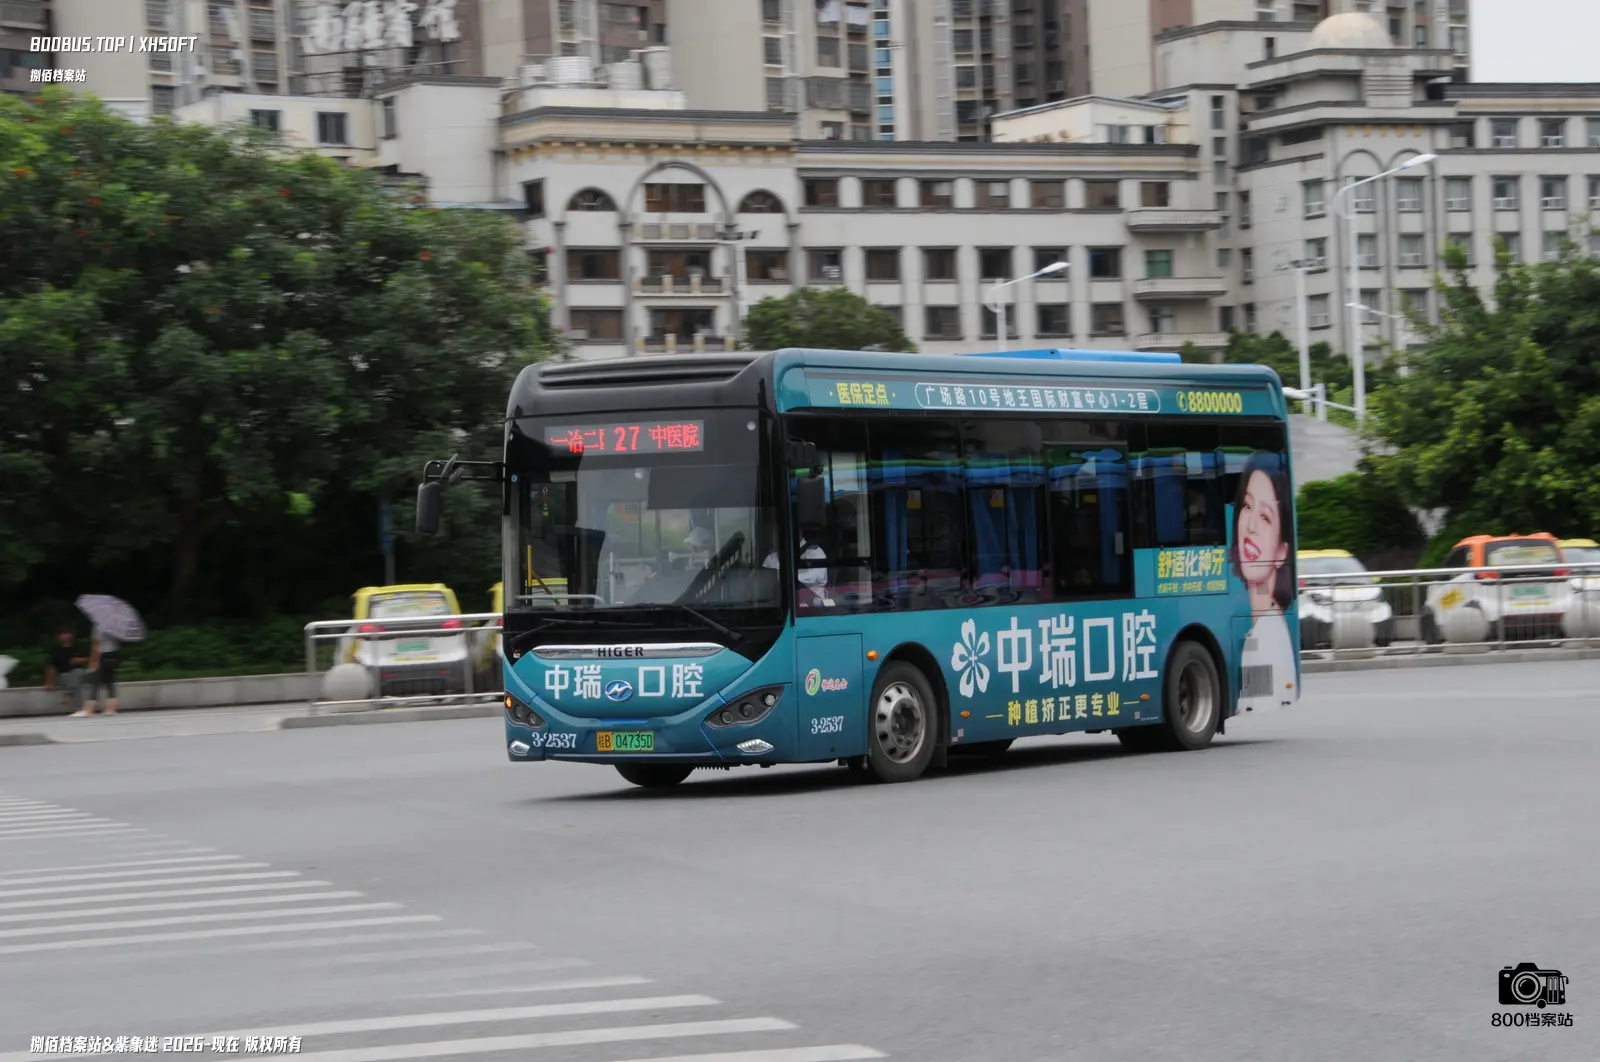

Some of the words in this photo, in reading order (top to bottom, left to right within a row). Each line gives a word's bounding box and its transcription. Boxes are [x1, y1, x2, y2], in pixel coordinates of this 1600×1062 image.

[1188, 391, 1243, 414] 8800000
[614, 425, 640, 451] 27
[650, 423, 700, 449] 中医院
[1158, 548, 1225, 578] 舒适化种牙
[597, 646, 644, 657] HIGER
[996, 608, 1159, 693] 中瑞口腔
[544, 664, 601, 700] 中瑞
[637, 663, 704, 699] 口腔
[1007, 691, 1120, 726] 种植矫正更专业
[811, 715, 844, 734] 3-2537
[531, 731, 577, 749] 3-2537
[615, 733, 653, 749] 04735D
